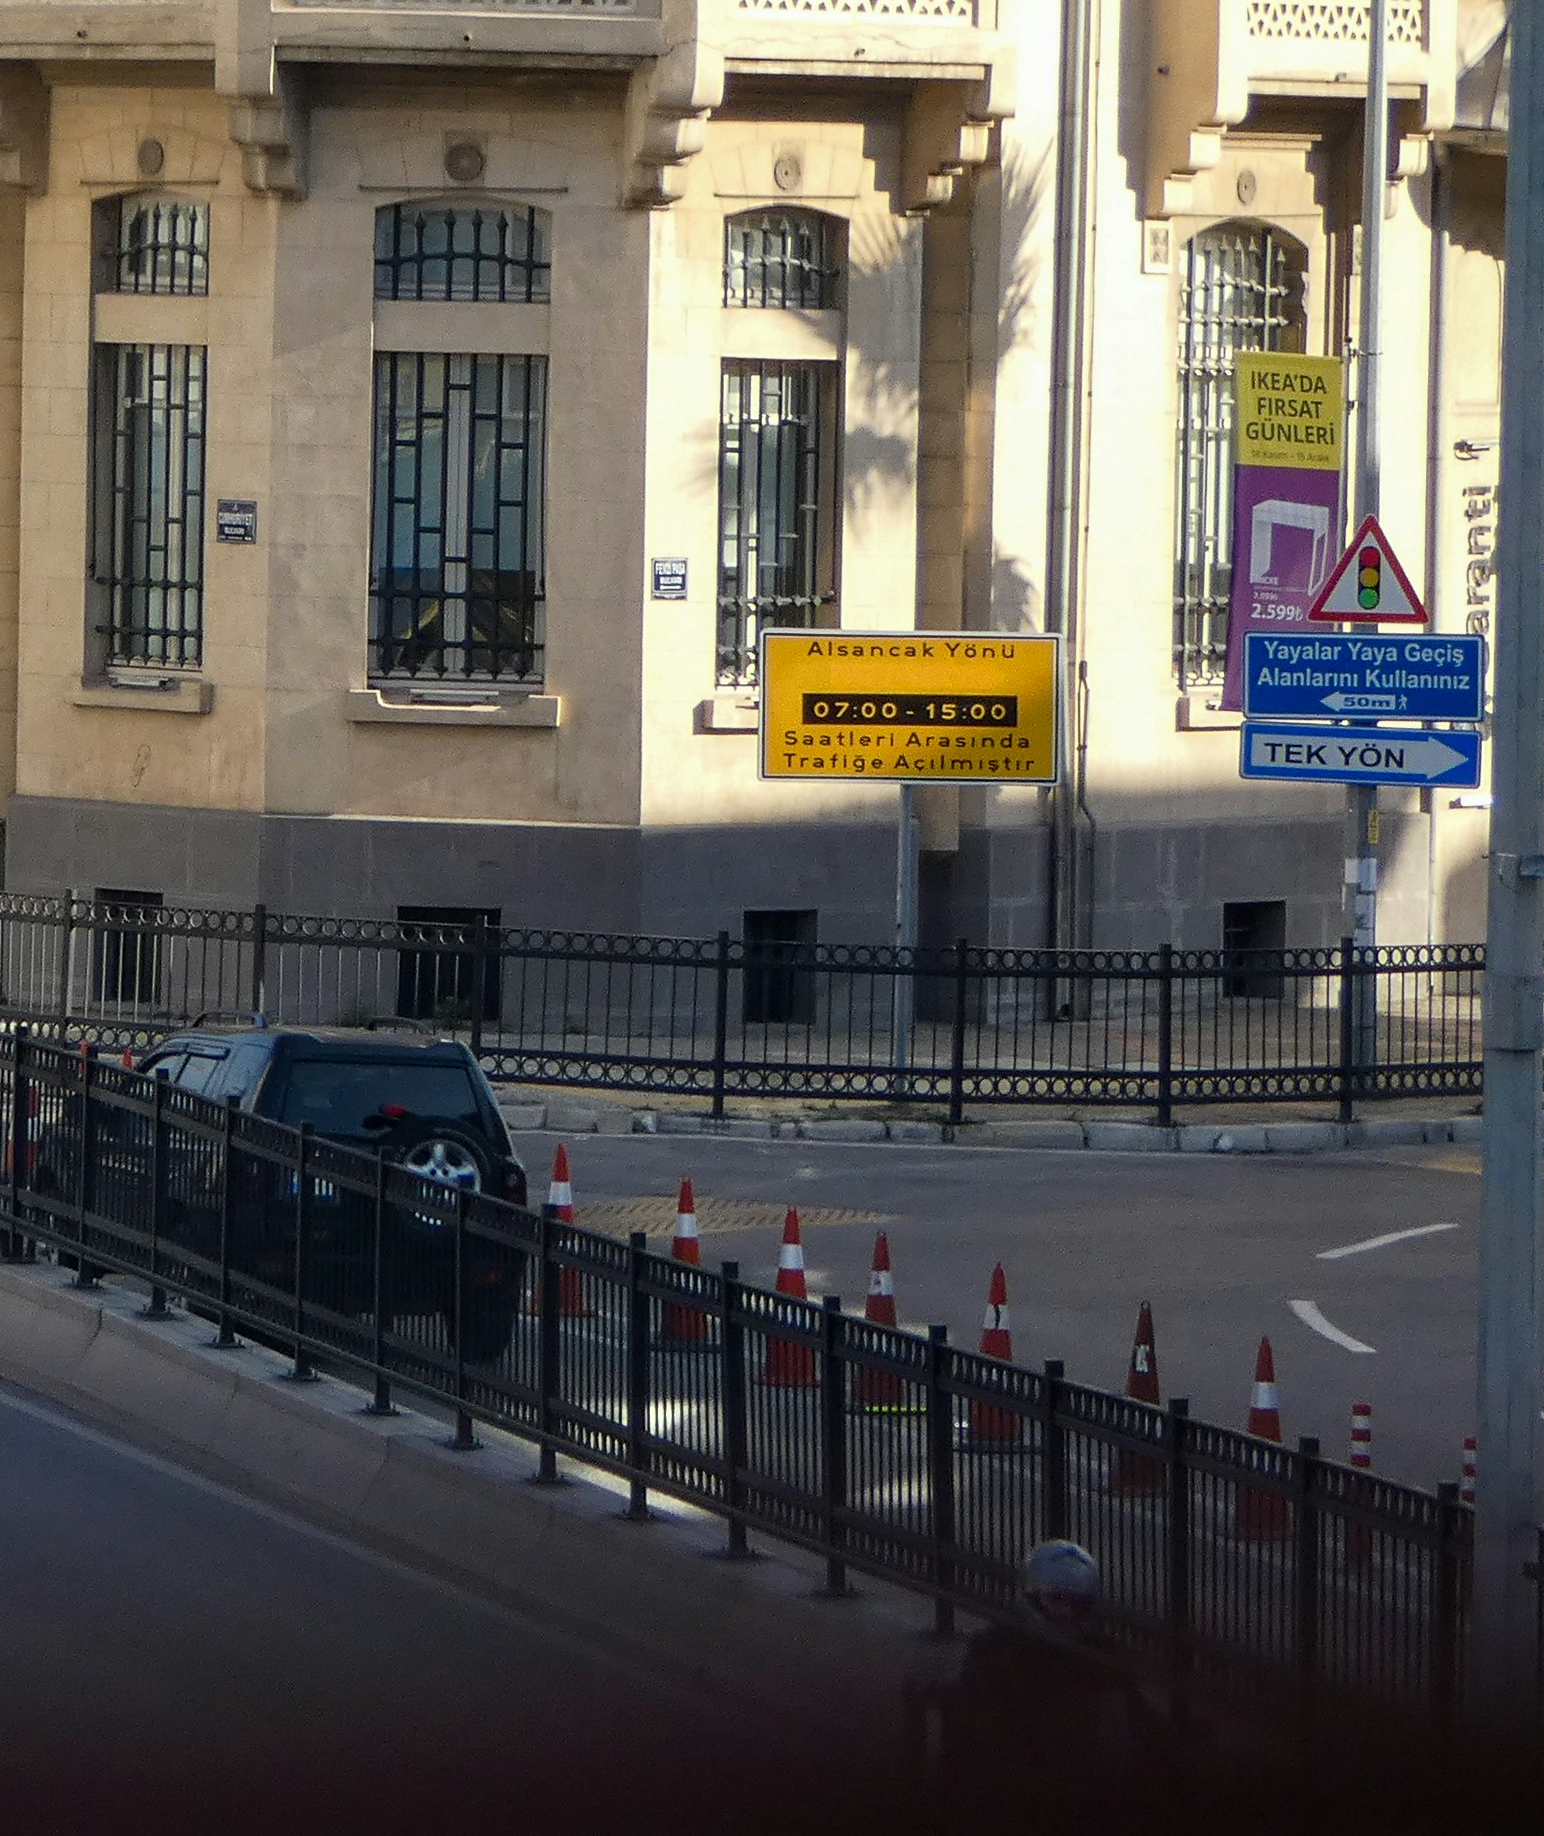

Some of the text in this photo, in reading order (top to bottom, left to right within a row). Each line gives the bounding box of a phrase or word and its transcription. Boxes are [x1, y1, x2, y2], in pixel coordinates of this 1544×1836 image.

[1251, 370, 1328, 395] IKEA'DA
[1257, 396, 1323, 419] FIRSAT
[1245, 417, 1335, 445] GÜNLERİ
[1462, 485, 1492, 635] aranti
[808, 641, 1015, 659] Alsancak Yönü
[1264, 640, 1464, 667] Yayalar Yaya Geçiş
[1257, 667, 1470, 690] Alanlarını Kullanınız
[814, 702, 898, 719] 07:00
[925, 702, 1007, 721] 15:00
[1343, 695, 1391, 709] 50m
[784, 731, 1031, 750] Saatleri Arasında
[782, 752, 1036, 773] Trafiğe Açılmıştır
[1264, 742, 1404, 769] TEK YÖN
